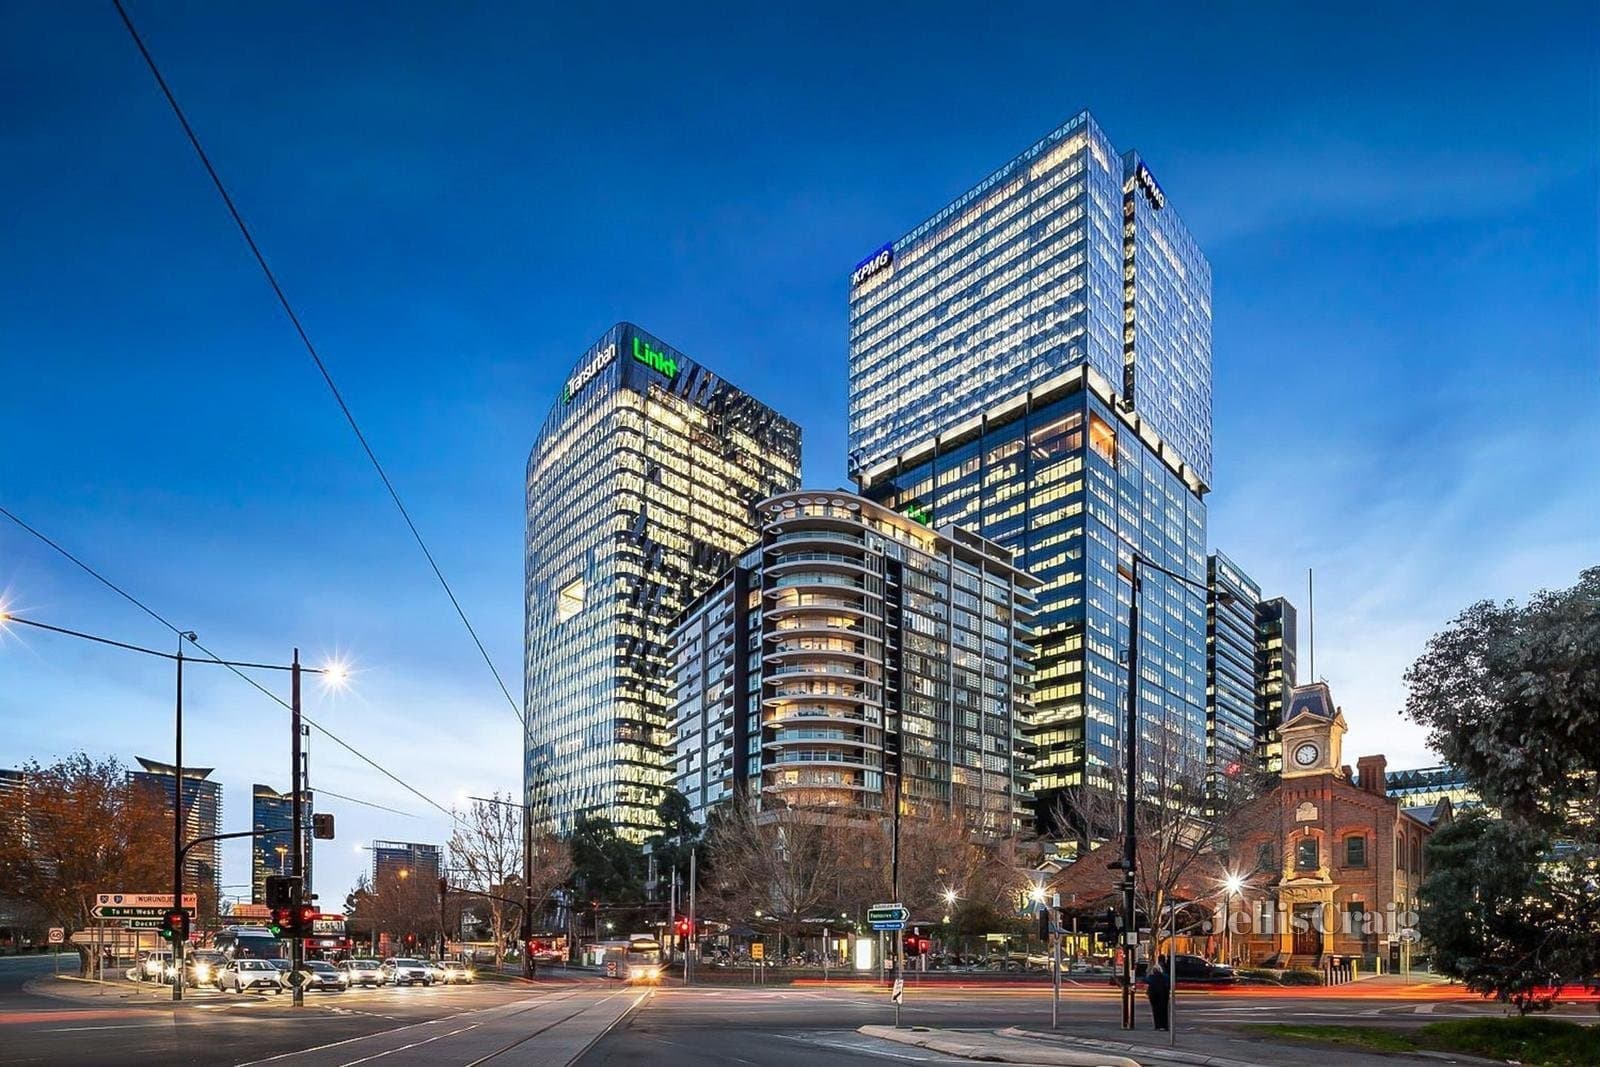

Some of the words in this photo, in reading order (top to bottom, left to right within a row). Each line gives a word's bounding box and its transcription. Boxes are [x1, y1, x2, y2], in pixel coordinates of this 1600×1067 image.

[1141, 166, 1164, 208] KPMG
[852, 250, 889, 285] KPMG
[567, 343, 616, 397] Transurban
[633, 336, 677, 378] Linkt
